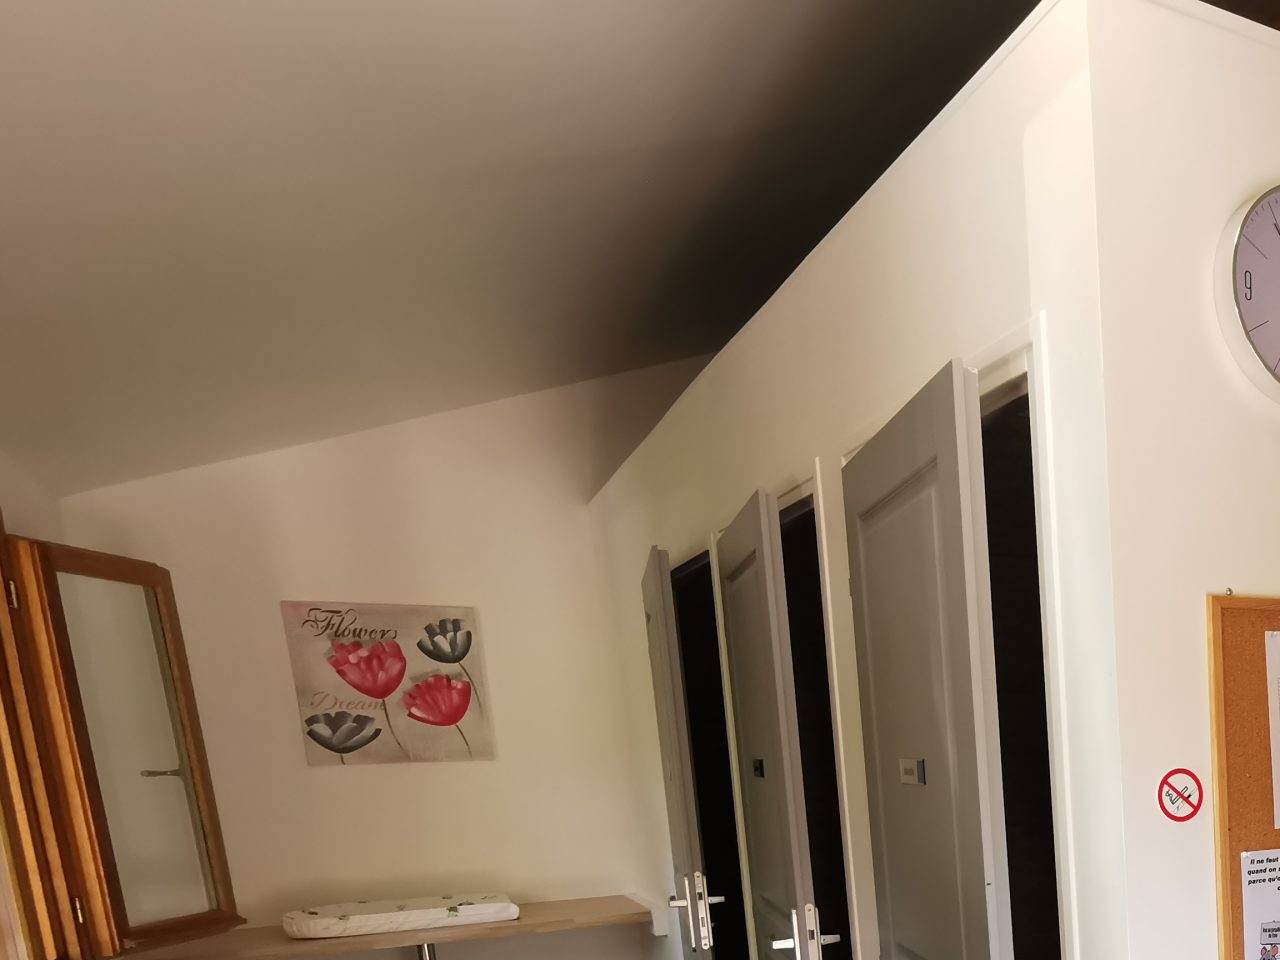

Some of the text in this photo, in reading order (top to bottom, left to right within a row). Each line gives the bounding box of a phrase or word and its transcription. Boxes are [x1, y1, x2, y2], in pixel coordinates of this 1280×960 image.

[1244, 270, 1252, 300] 9
[301, 607, 398, 640] Flowers
[1248, 867, 1267, 876] quand
[1248, 878, 1266, 886] parce
